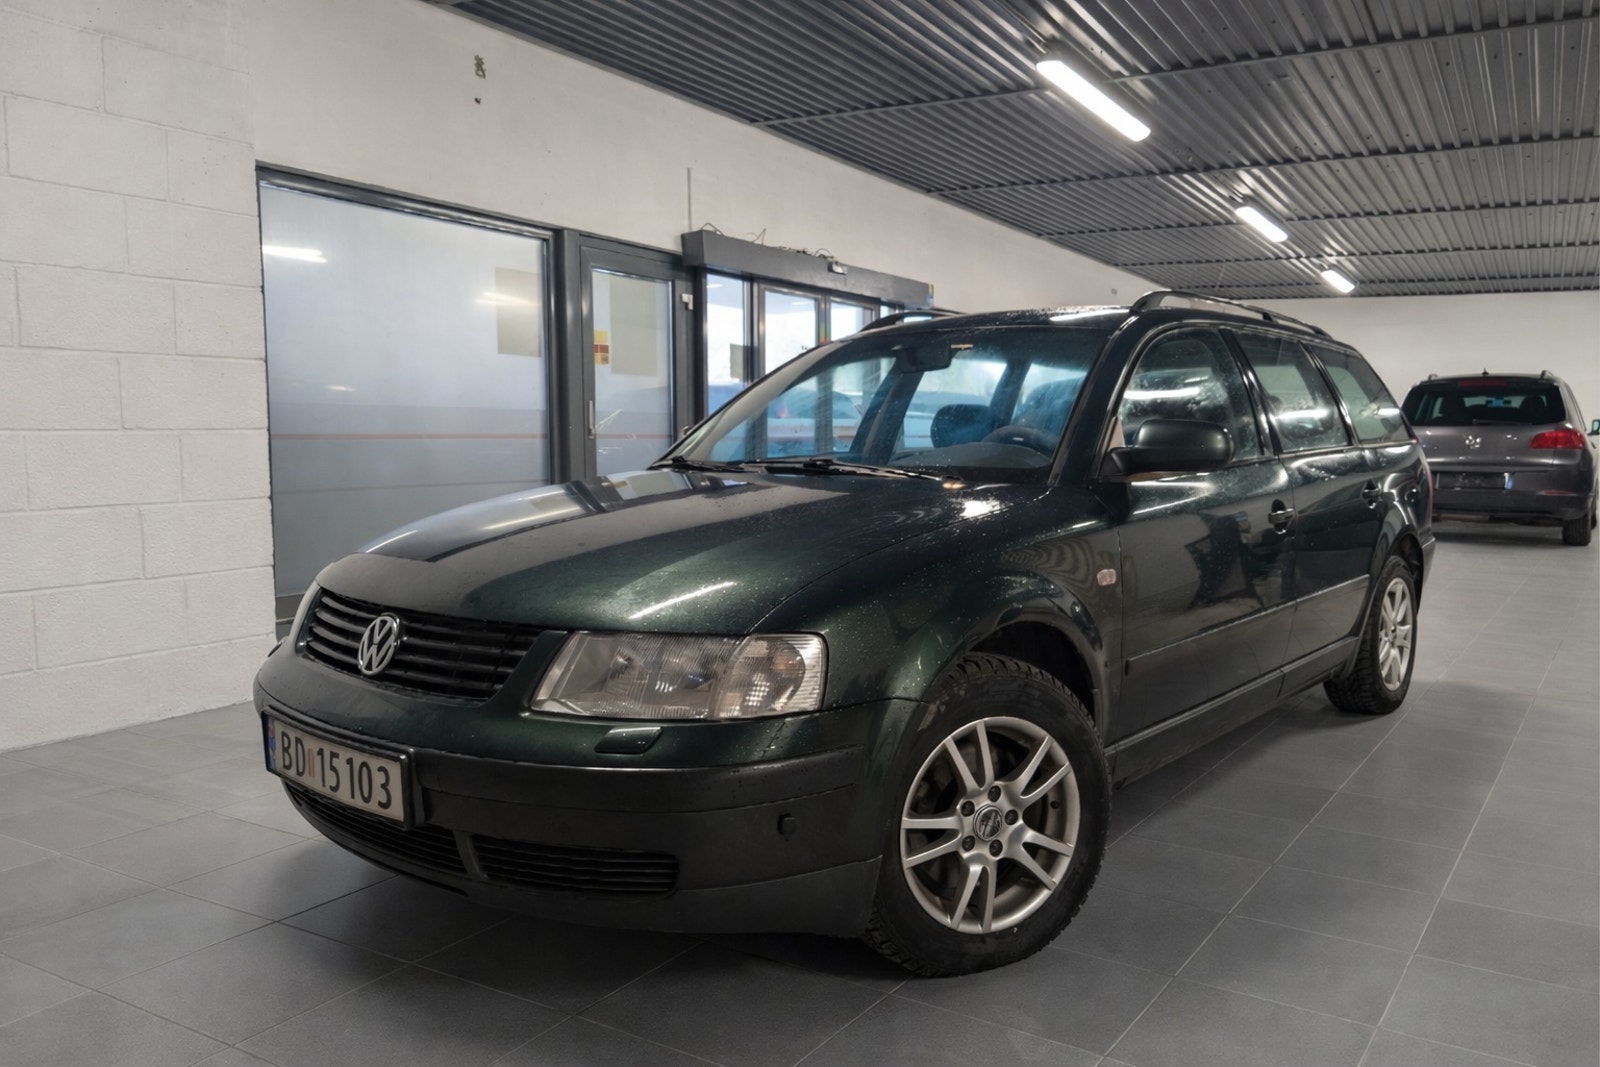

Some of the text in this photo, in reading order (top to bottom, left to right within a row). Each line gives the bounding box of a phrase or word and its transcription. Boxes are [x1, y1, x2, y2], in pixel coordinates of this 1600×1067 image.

[359, 616, 396, 675] VW
[281, 730, 392, 810] BD 15103
